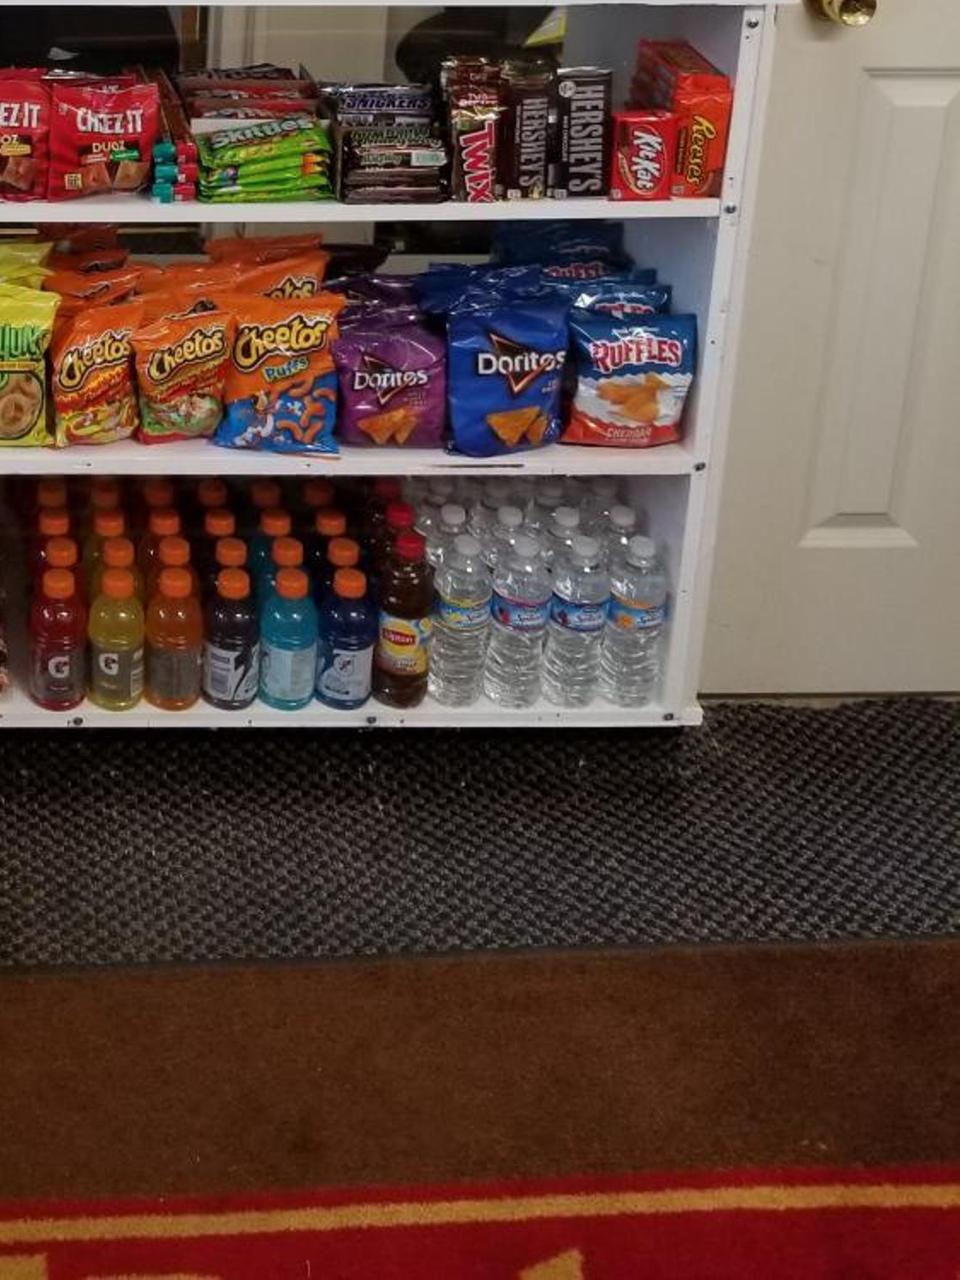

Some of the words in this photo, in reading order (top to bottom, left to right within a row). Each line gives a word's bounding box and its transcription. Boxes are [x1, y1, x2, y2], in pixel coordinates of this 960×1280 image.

[459, 121, 496, 203] TWIX
[60, 329, 132, 387] Cheetos
[148, 329, 225, 384] Cheetos
[234, 315, 328, 369] Cheetos
[590, 335, 682, 372] RUFFLES
[354, 370, 428, 390] Doritos
[477, 351, 566, 374] Doritos
[48, 656, 70, 678] G
[99, 653, 119, 675] G
